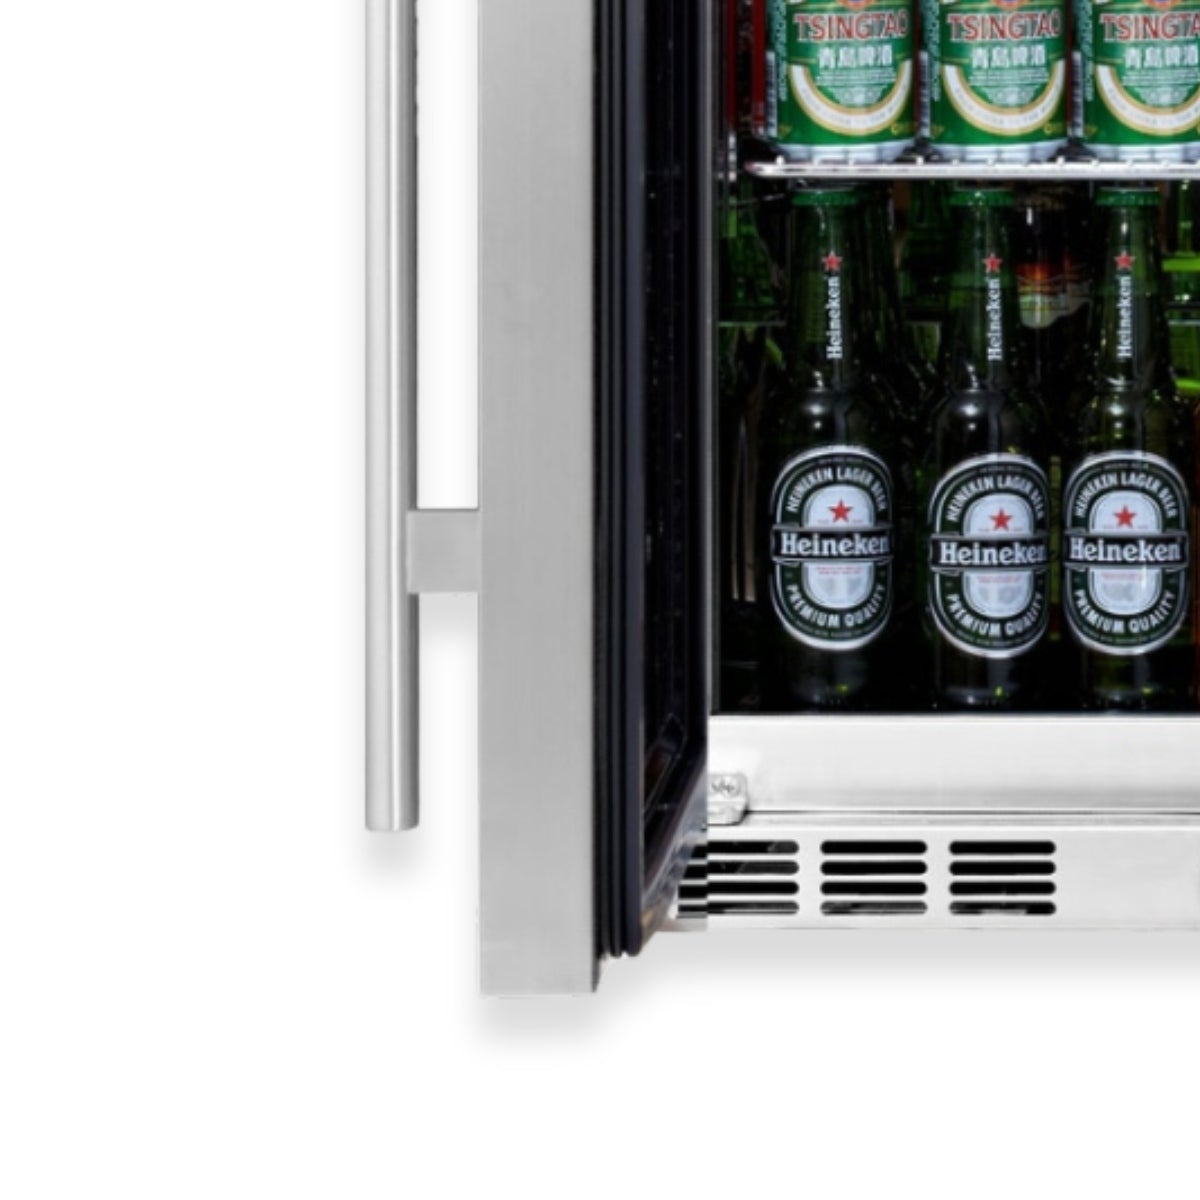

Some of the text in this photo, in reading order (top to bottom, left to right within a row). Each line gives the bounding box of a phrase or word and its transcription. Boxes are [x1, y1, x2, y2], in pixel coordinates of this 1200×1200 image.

[793, 10, 908, 42] TSINGTAO
[946, 10, 1062, 42] TSINGTAO
[826, 276, 843, 360] Heineken
[987, 277, 1003, 361] Heineken
[1117, 275, 1133, 359] Heineken
[1069, 536, 1182, 562] Heineken
